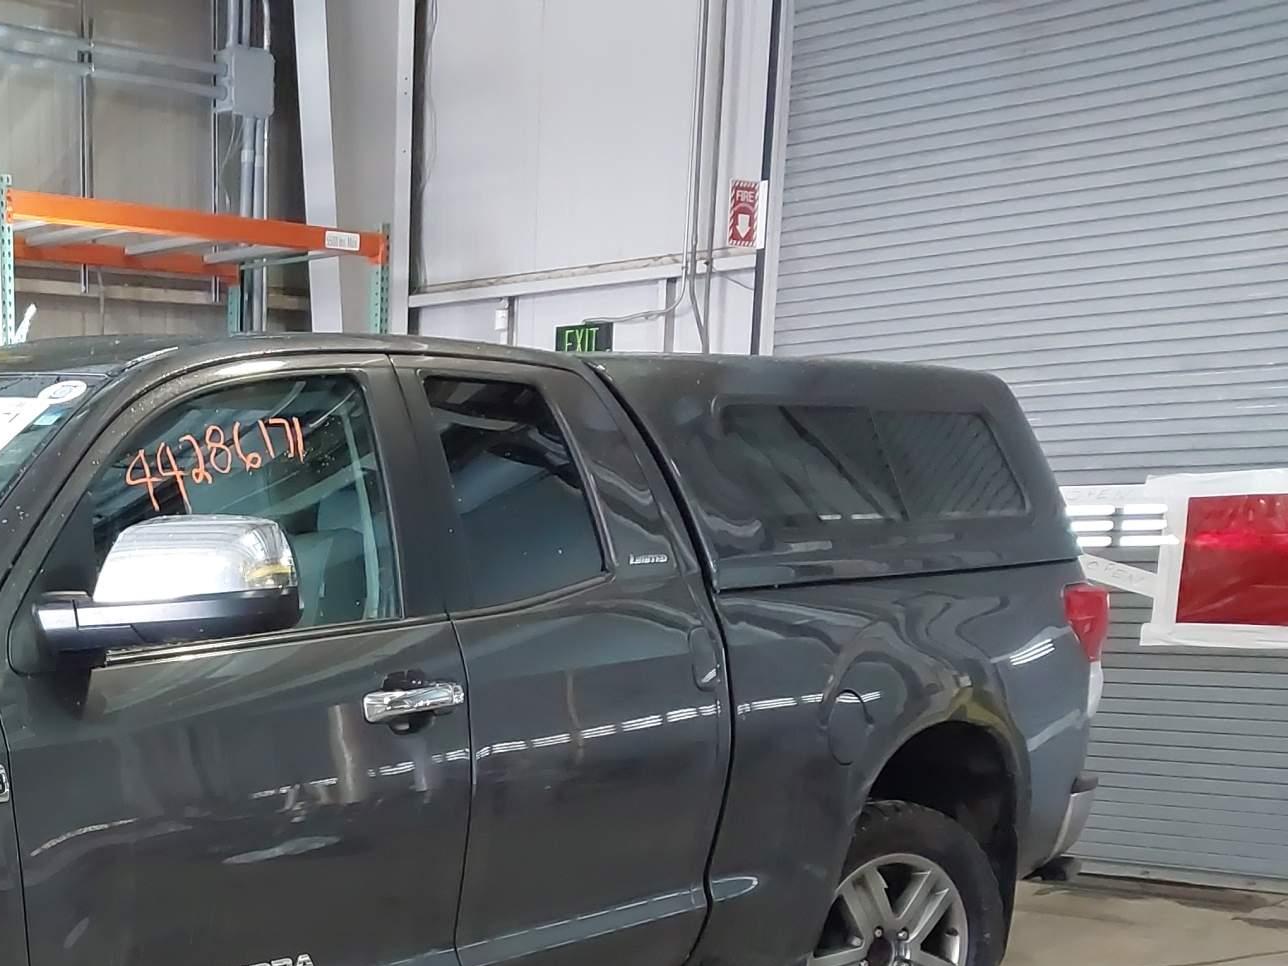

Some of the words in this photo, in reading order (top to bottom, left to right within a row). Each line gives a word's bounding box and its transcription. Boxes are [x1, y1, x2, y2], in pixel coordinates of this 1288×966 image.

[735, 189, 755, 203] FIRE
[565, 327, 599, 352] EXIT
[125, 416, 305, 514] 44286171
